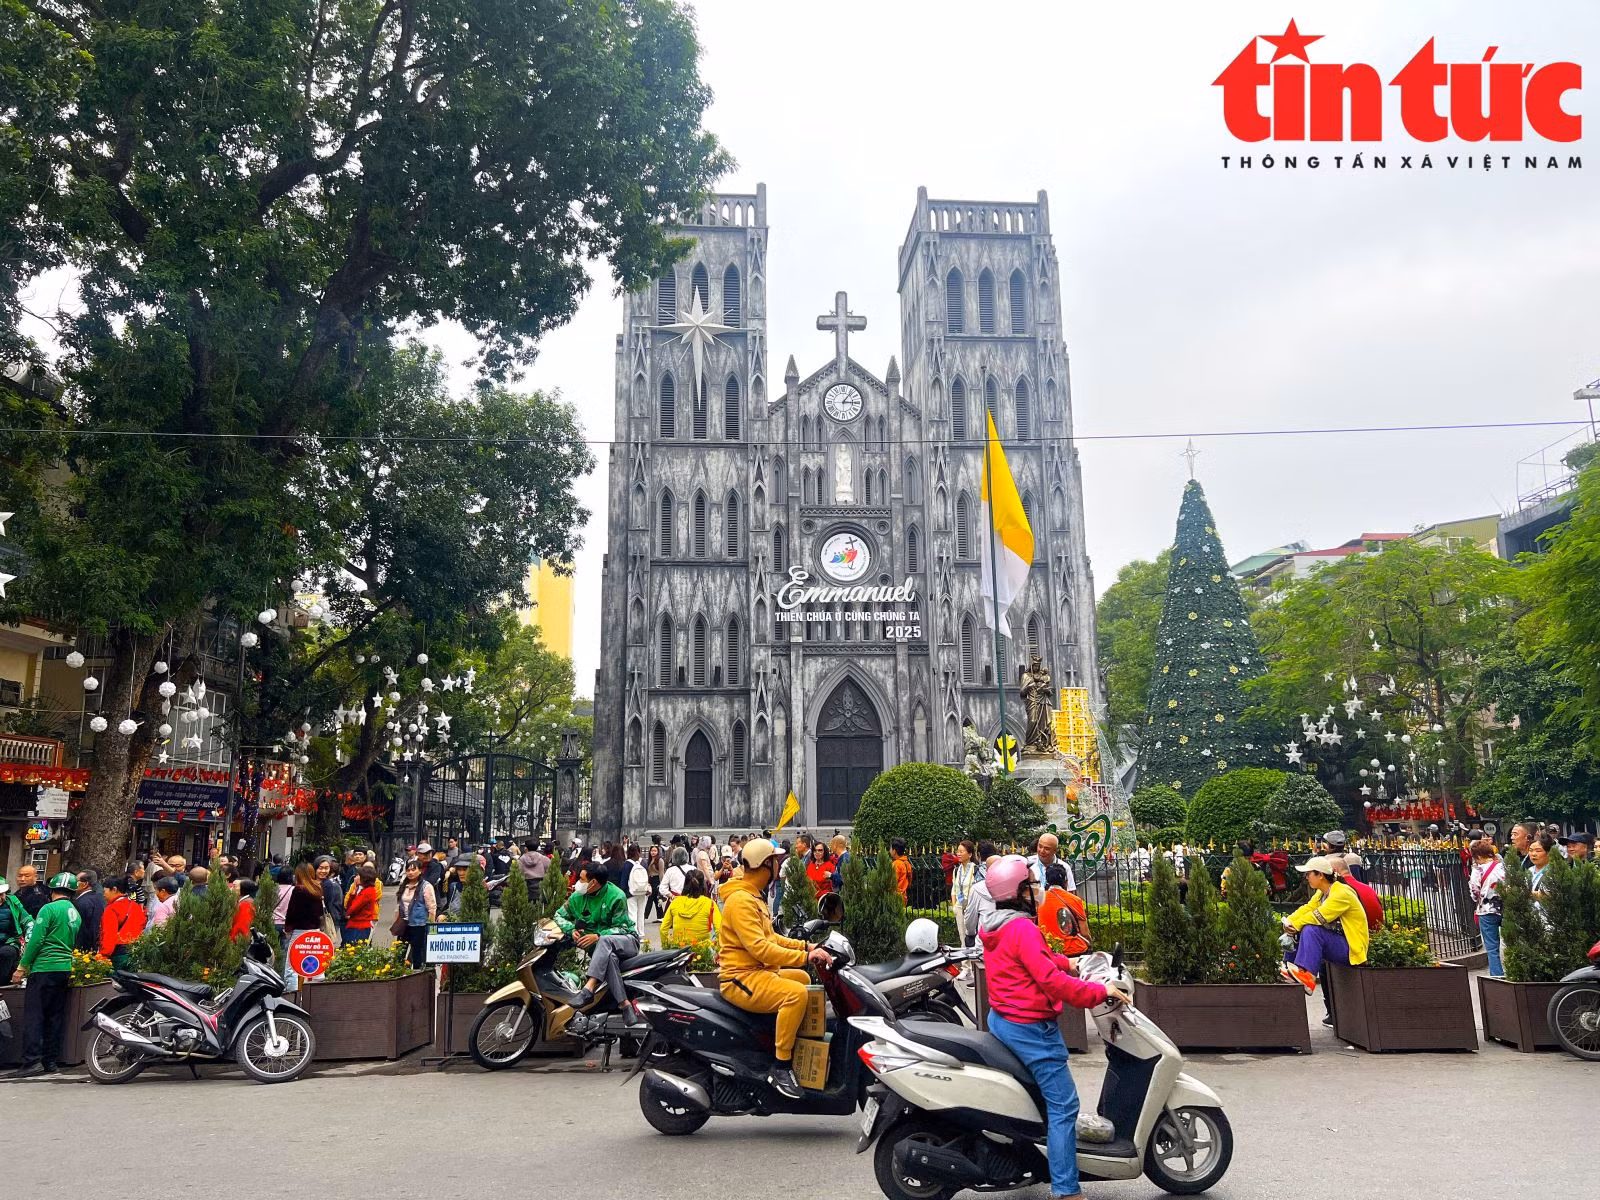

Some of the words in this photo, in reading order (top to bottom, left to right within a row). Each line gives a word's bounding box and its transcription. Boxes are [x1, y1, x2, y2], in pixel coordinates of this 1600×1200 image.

[777, 565, 916, 609] Emmanuel
[806, 609, 833, 621] CHÚA
[873, 609, 906, 621] CHÚNG
[909, 611, 920, 621] TA
[886, 626, 922, 638] 2025
[430, 938, 455, 952] KHÔNG
[468, 940, 478, 951] XE
[914, 1072, 953, 1081] LEAD
